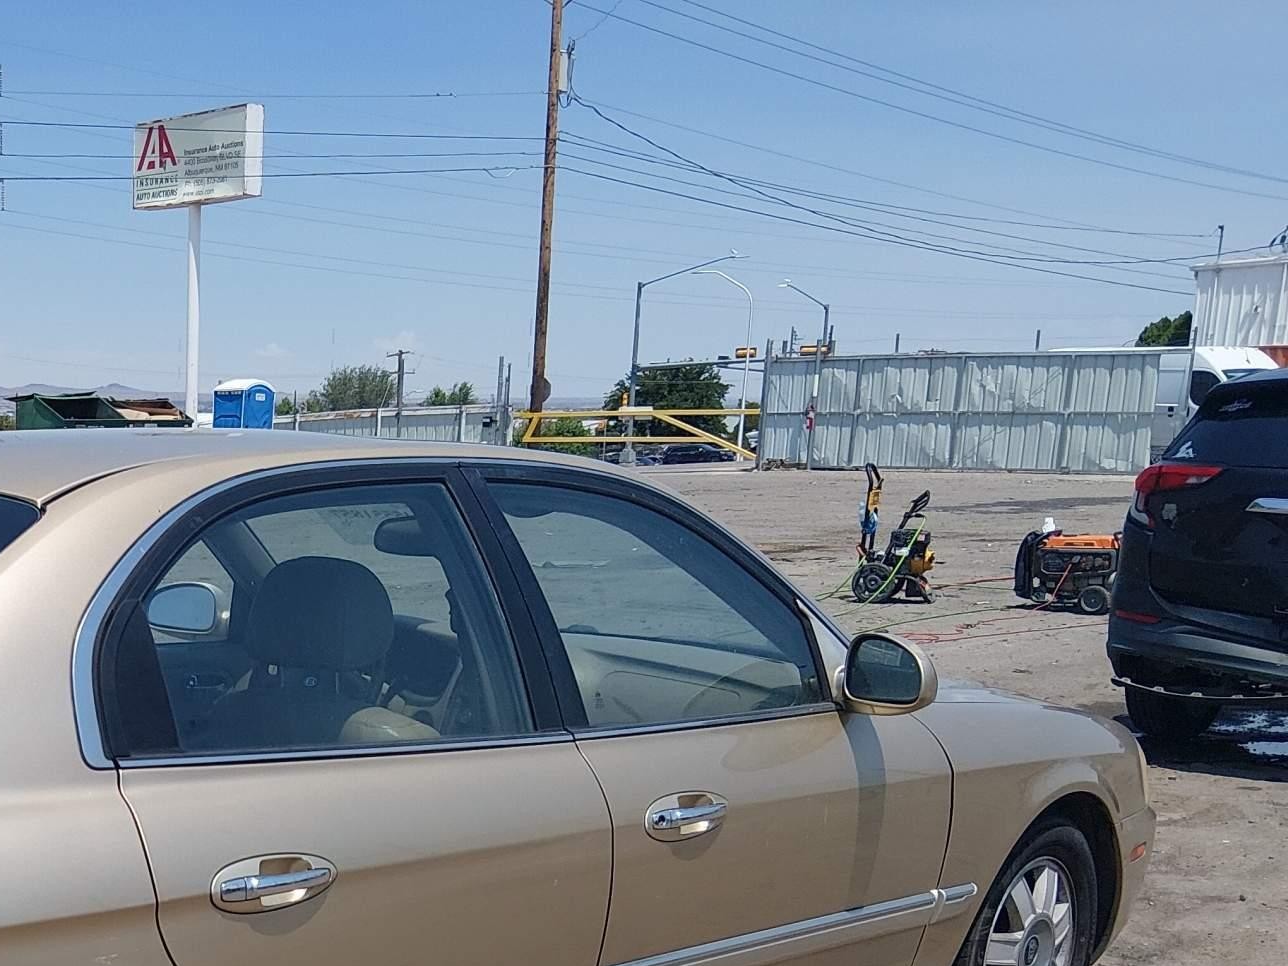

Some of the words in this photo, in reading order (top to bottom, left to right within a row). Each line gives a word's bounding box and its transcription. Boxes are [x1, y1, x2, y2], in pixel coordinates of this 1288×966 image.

[208, 144, 220, 153] Auto
[220, 140, 244, 150] Auctions
[136, 174, 178, 188] INSURANCE
[136, 191, 151, 202] AUTO
[151, 188, 178, 200] AUCTIONS
